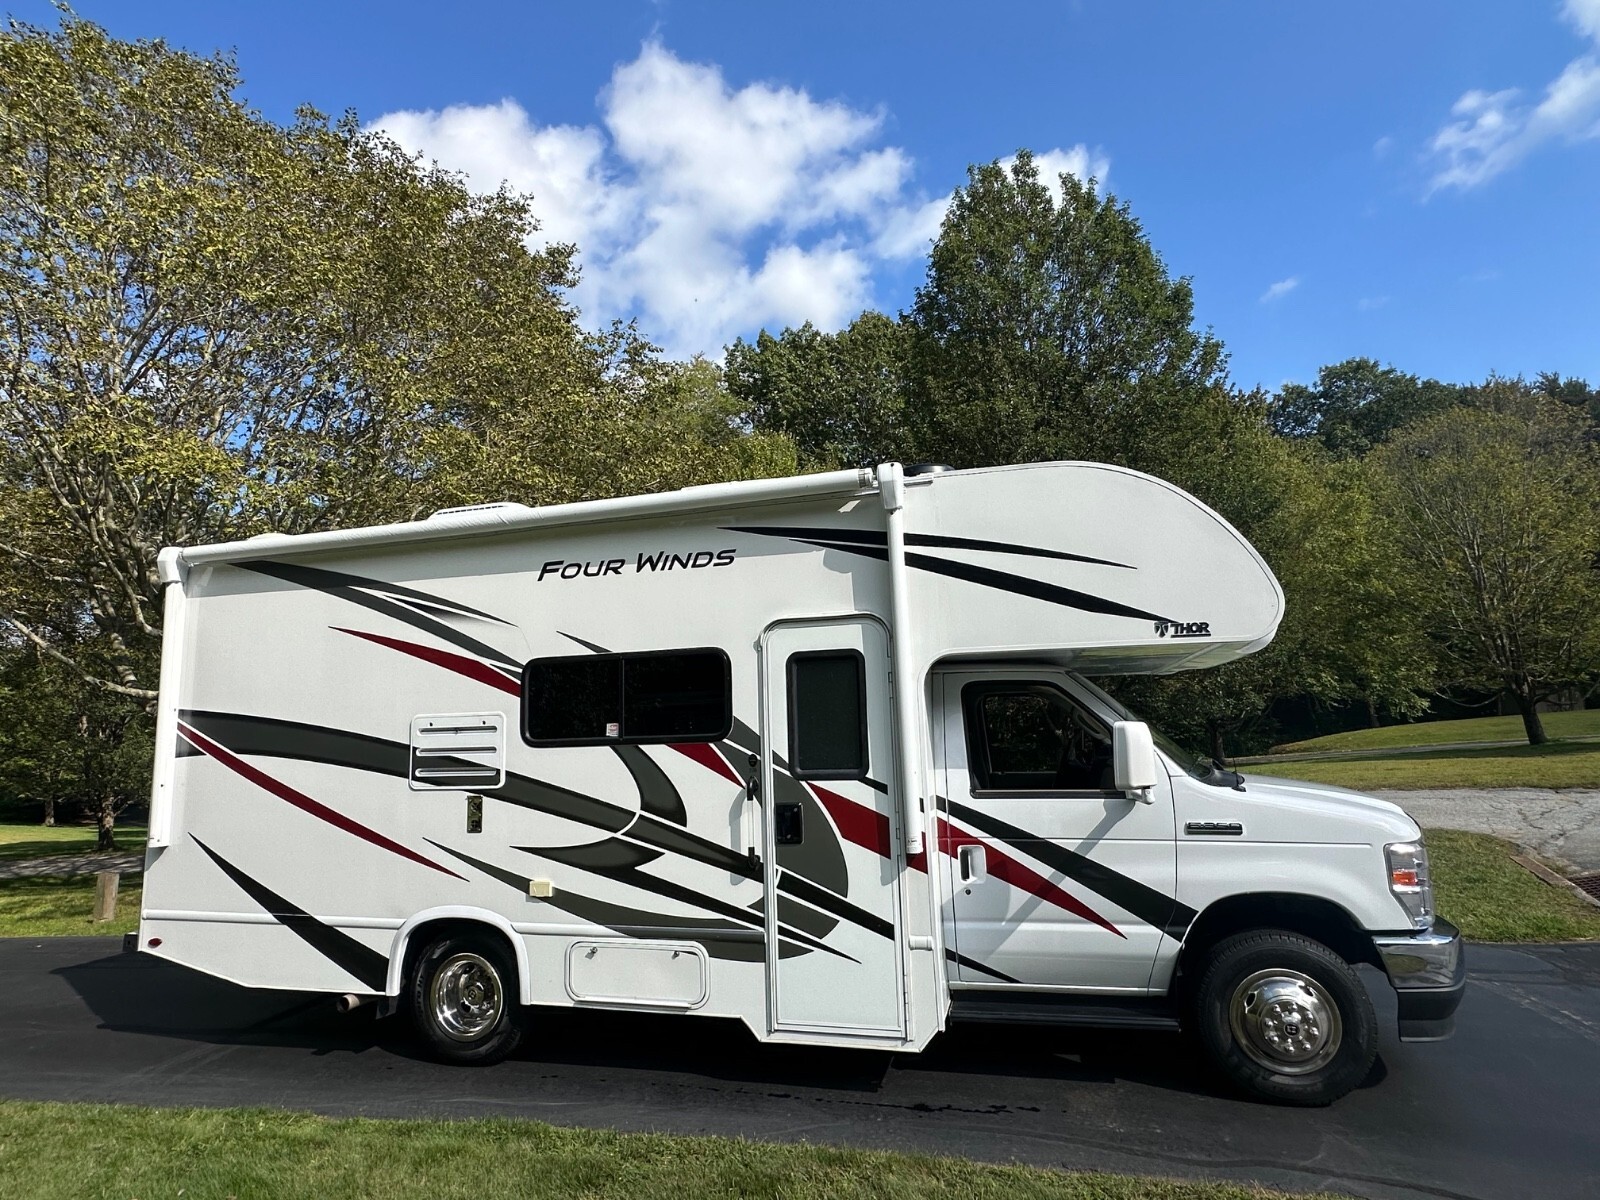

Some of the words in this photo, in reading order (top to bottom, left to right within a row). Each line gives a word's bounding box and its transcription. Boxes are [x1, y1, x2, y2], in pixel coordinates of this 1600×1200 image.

[537, 558, 626, 582] FOUR
[635, 548, 737, 573] WINDS
[1169, 621, 1211, 635] THOR
